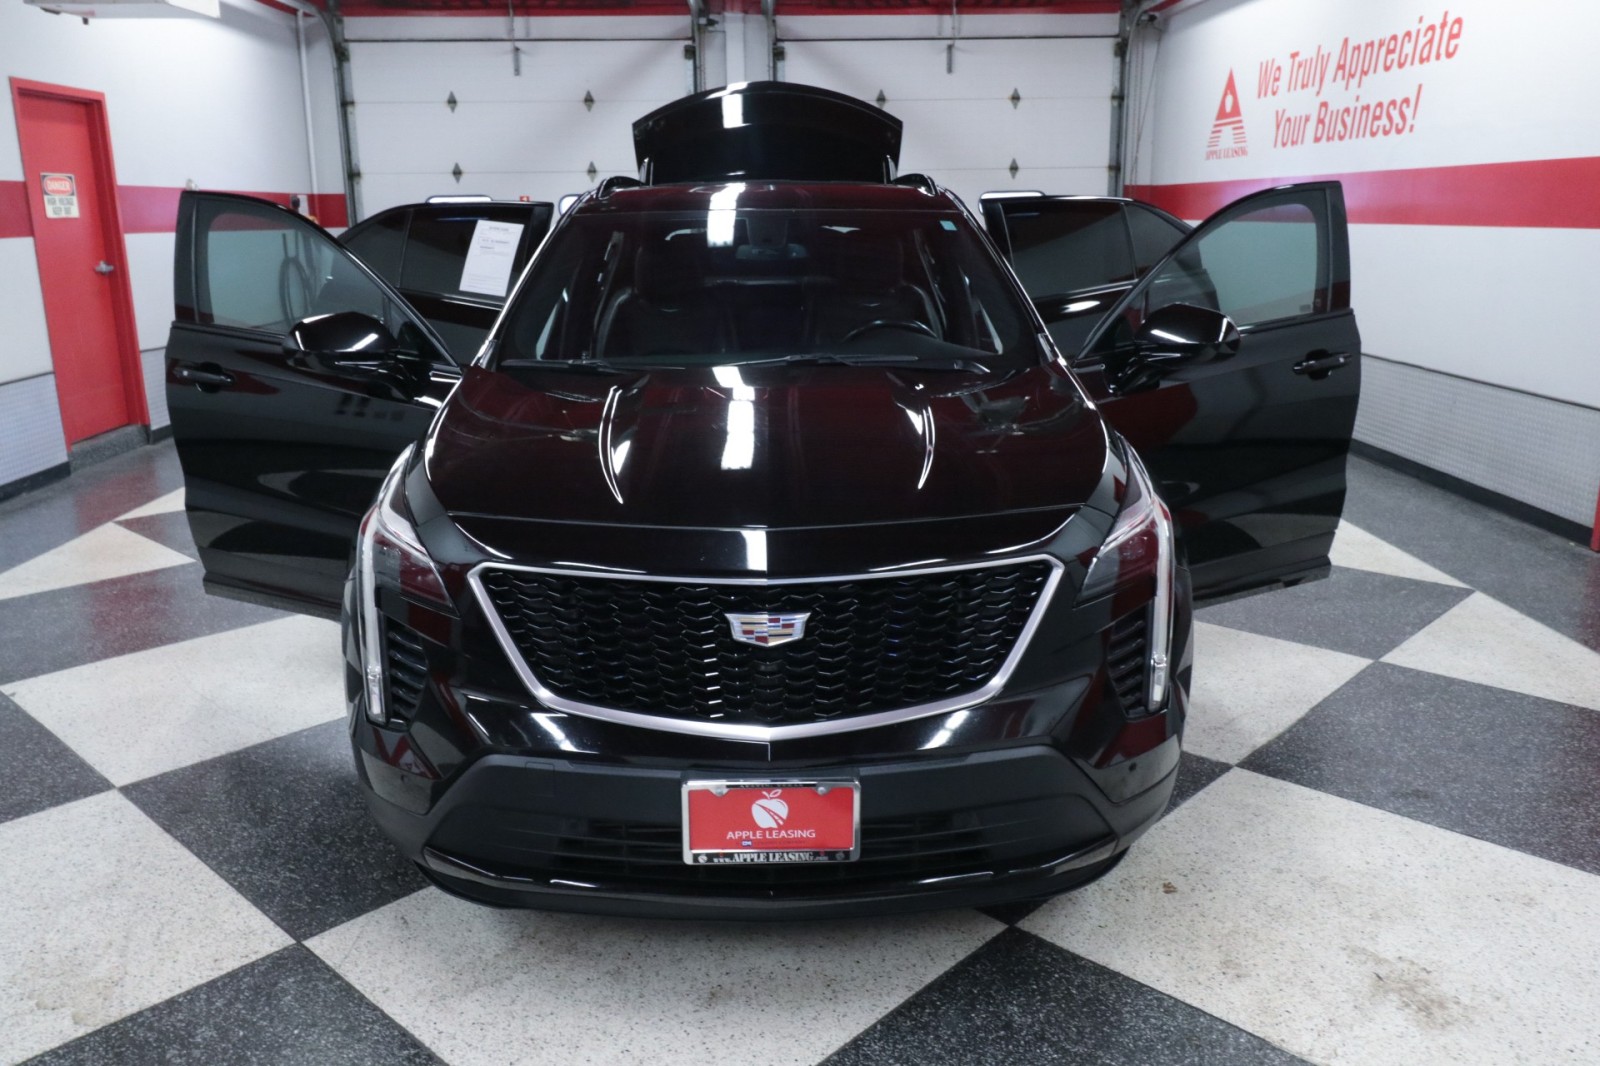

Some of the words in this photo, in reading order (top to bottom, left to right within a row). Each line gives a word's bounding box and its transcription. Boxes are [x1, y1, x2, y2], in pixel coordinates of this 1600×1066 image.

[1257, 58, 1282, 99] We
[1287, 45, 1331, 97] Truly
[1332, 10, 1463, 91] Appreciate
[1273, 108, 1311, 148] Your
[1313, 83, 1423, 143] Business!
[46, 180, 71, 190] DANGER
[726, 830, 763, 840] APPLE
[765, 829, 816, 839] LEASING
